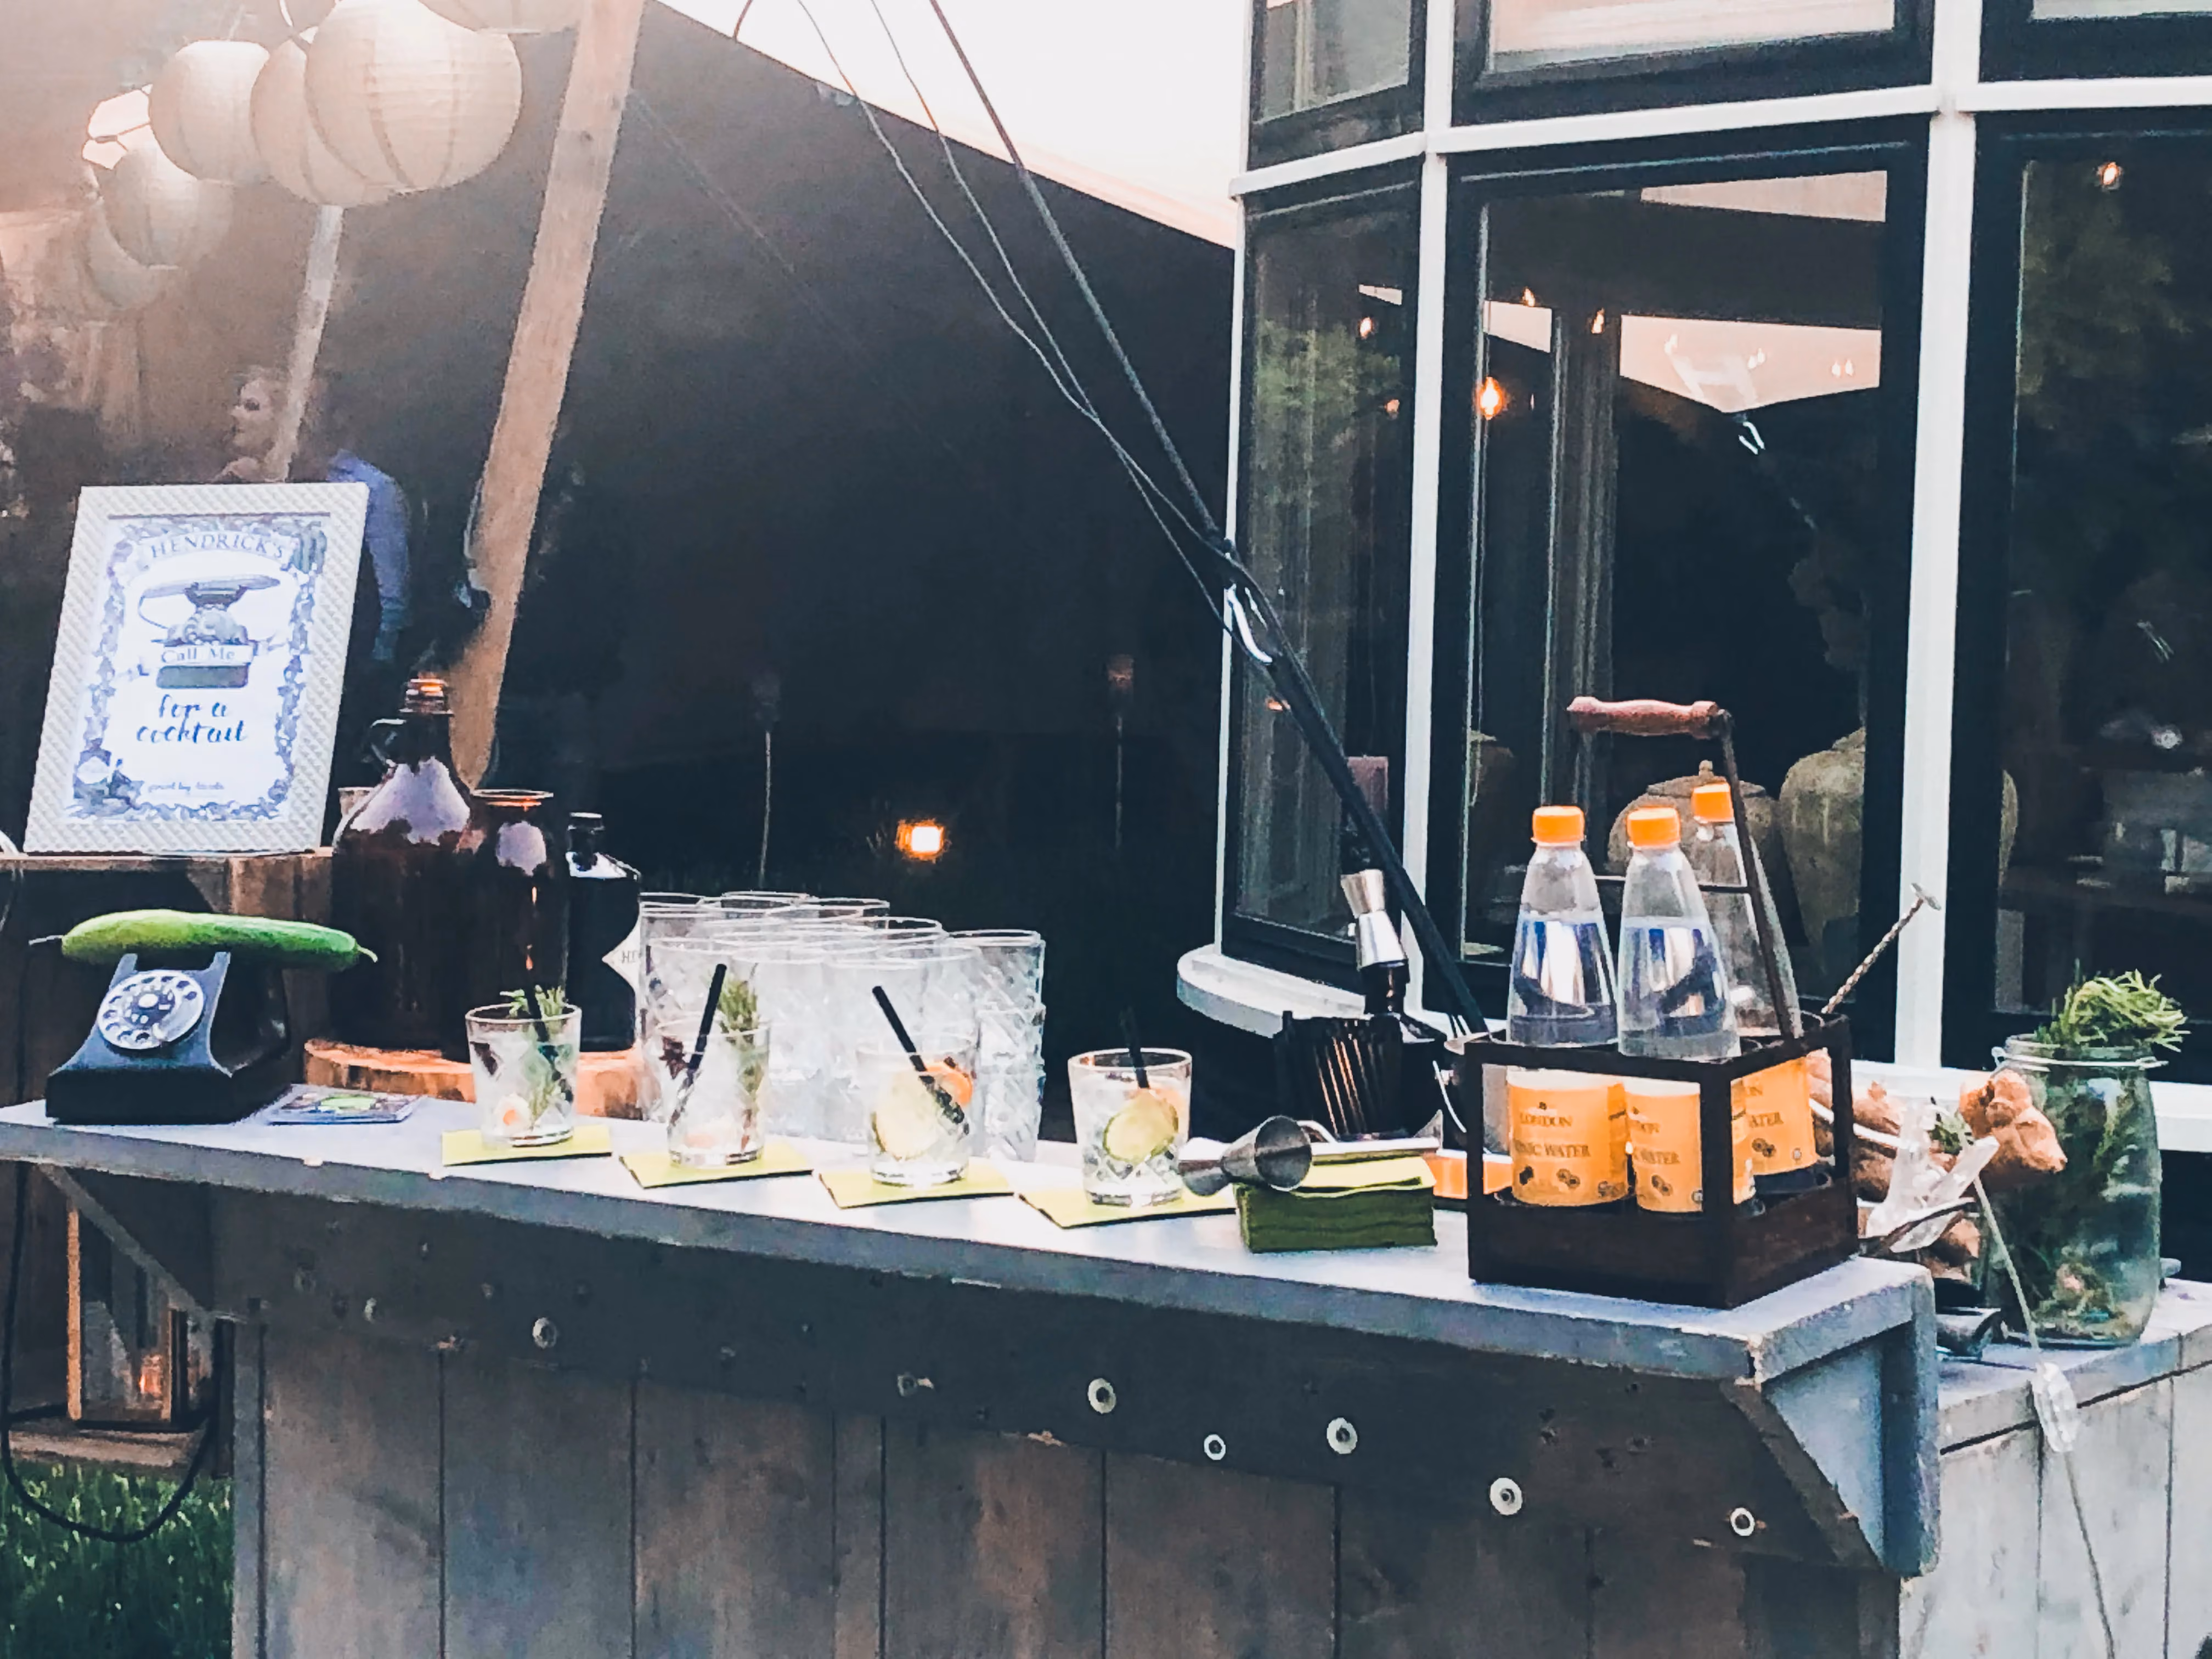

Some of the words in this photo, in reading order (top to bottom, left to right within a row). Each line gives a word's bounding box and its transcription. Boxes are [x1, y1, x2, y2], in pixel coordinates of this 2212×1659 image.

[161, 647, 197, 663] Call
[211, 647, 235, 659] Me
[159, 694, 201, 718] for
[212, 702, 227, 716] a
[137, 717, 249, 743] cocktail
[1748, 1111, 1784, 1127] ATER
[1544, 1144, 1591, 1158] WATER
